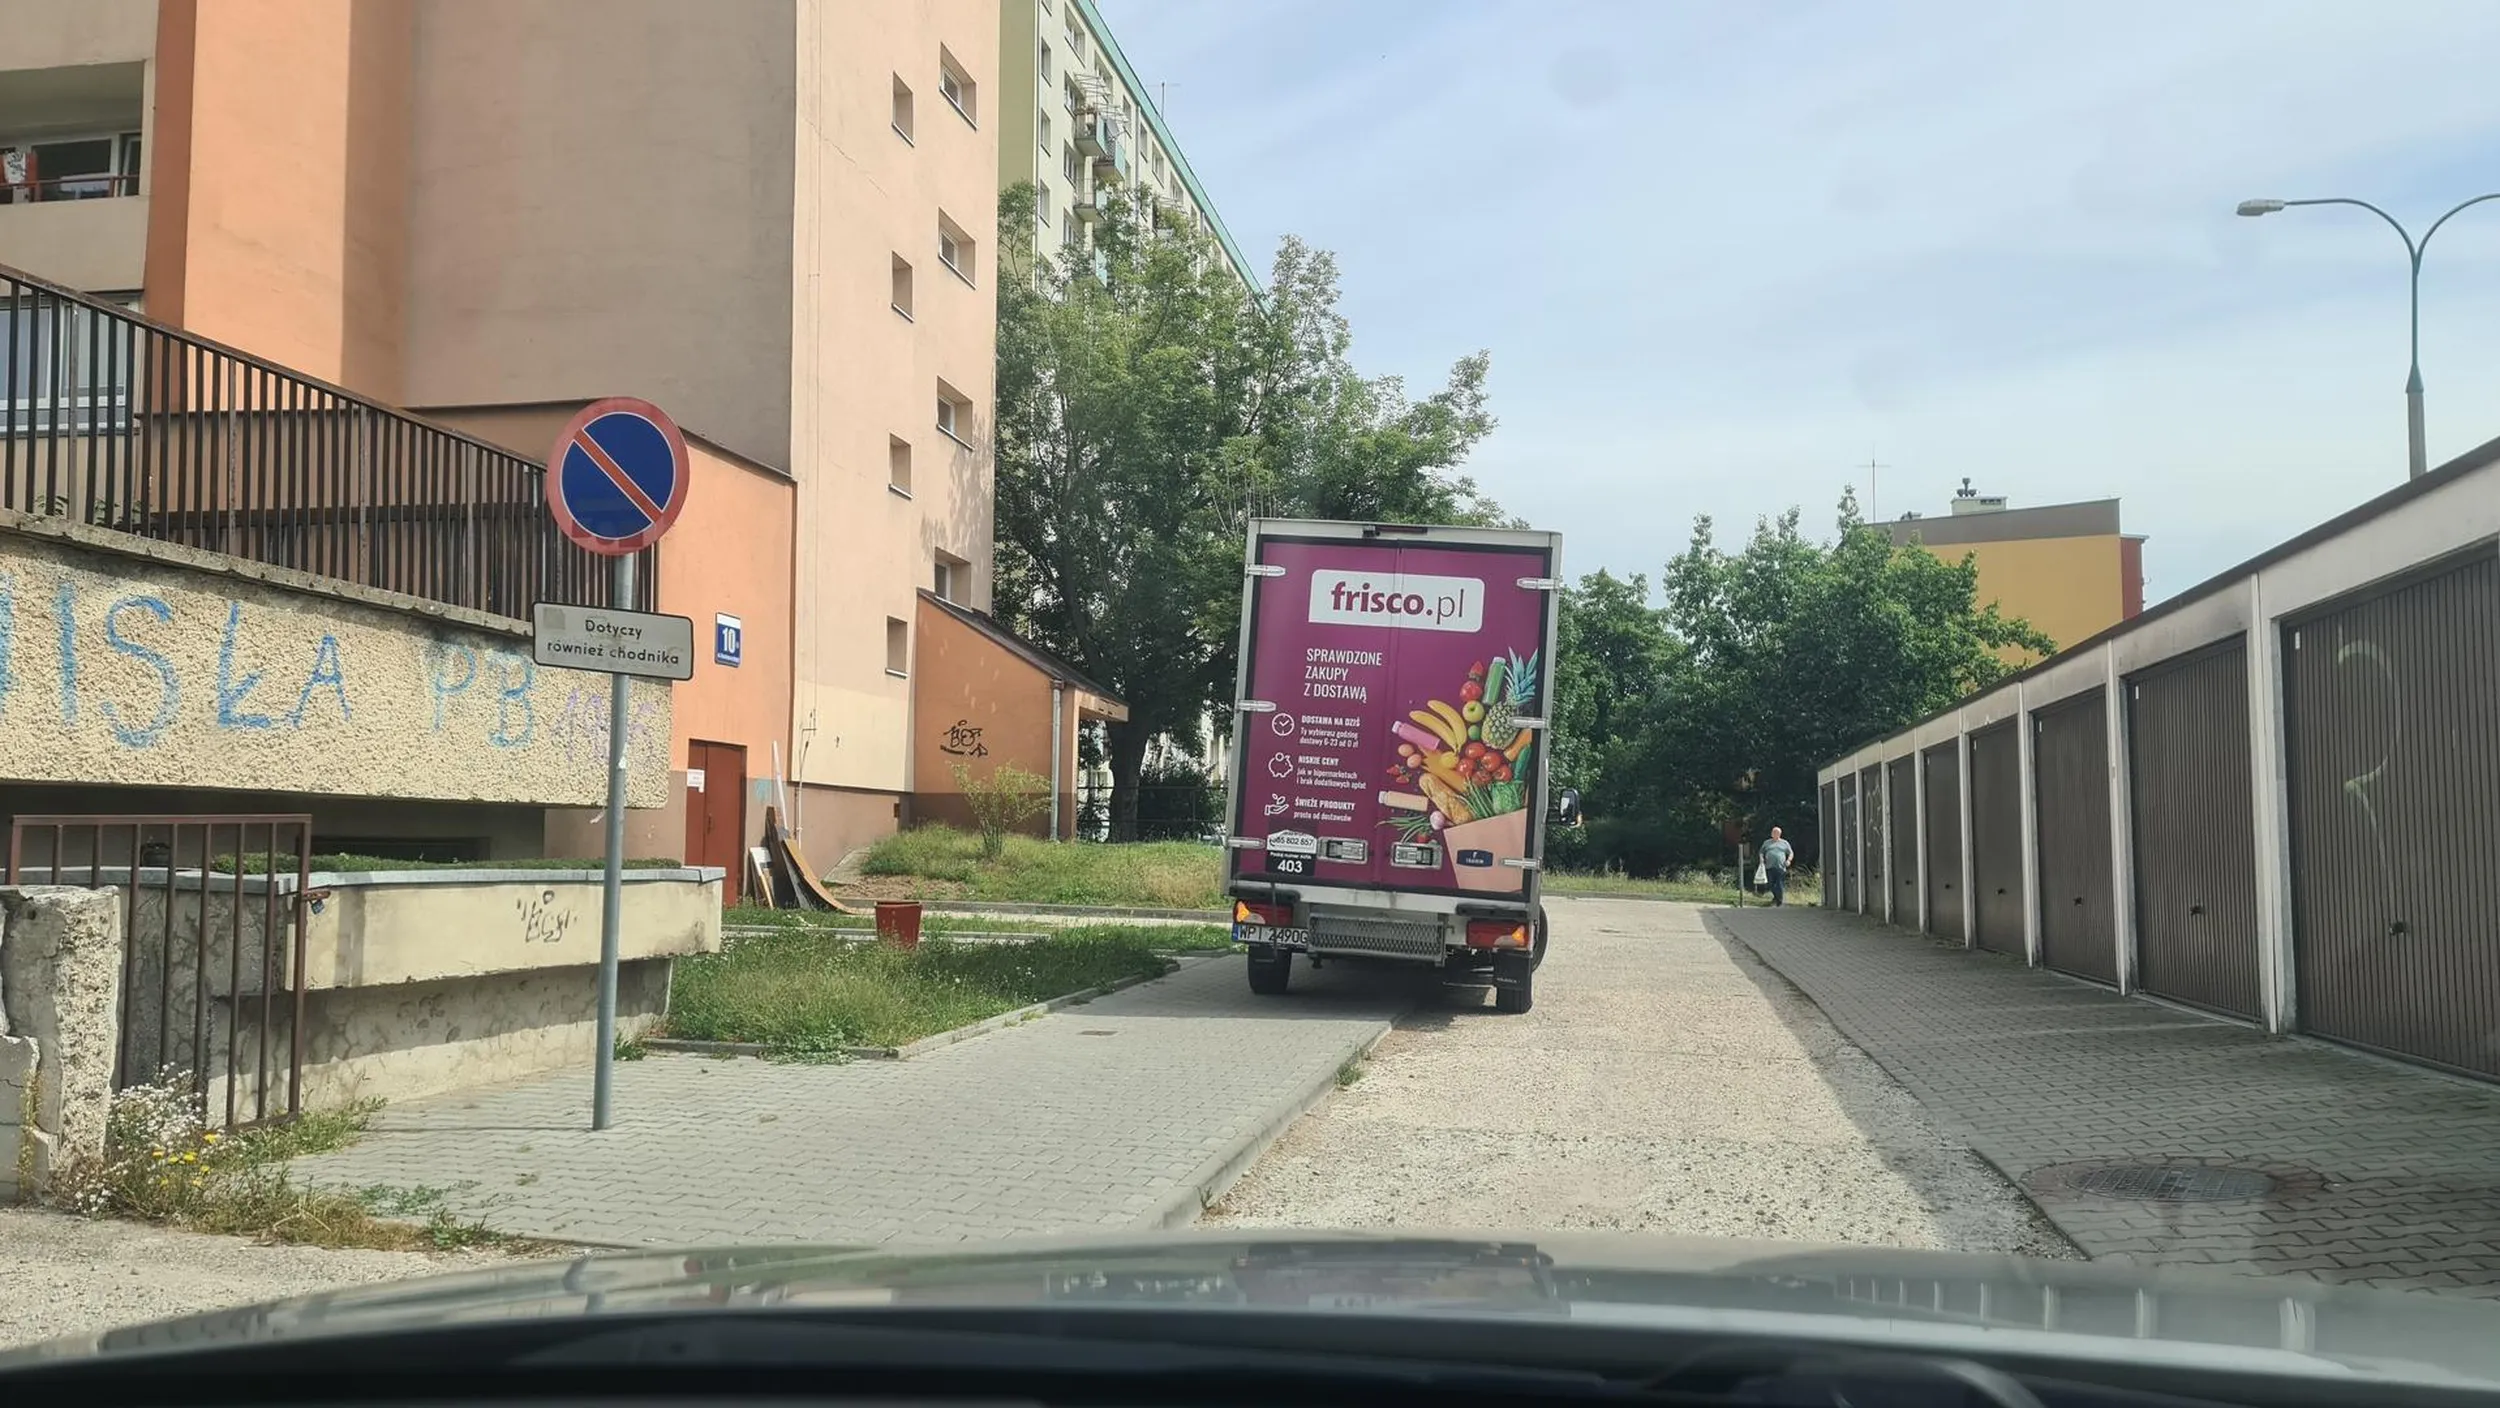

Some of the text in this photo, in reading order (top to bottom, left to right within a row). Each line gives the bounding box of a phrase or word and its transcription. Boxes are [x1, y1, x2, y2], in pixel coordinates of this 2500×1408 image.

[1331, 581, 1464, 624] frisco.pl
[585, 619, 642, 640] Dotyczy
[0, 573, 350, 748] ISŁA
[547, 639, 679, 665] również chodnika
[1306, 648, 1382, 666] SPRAWDZONE
[1305, 666, 1349, 681] ZAKUPY
[1303, 683, 1367, 703] Z DOSTAWĄ
[1301, 715, 1332, 725] DOSTAWA
[1334, 717, 1343, 726] NA
[1322, 757, 1339, 766] CENY
[1319, 799, 1356, 811] PRODUKTY
[1277, 859, 1303, 873] 403
